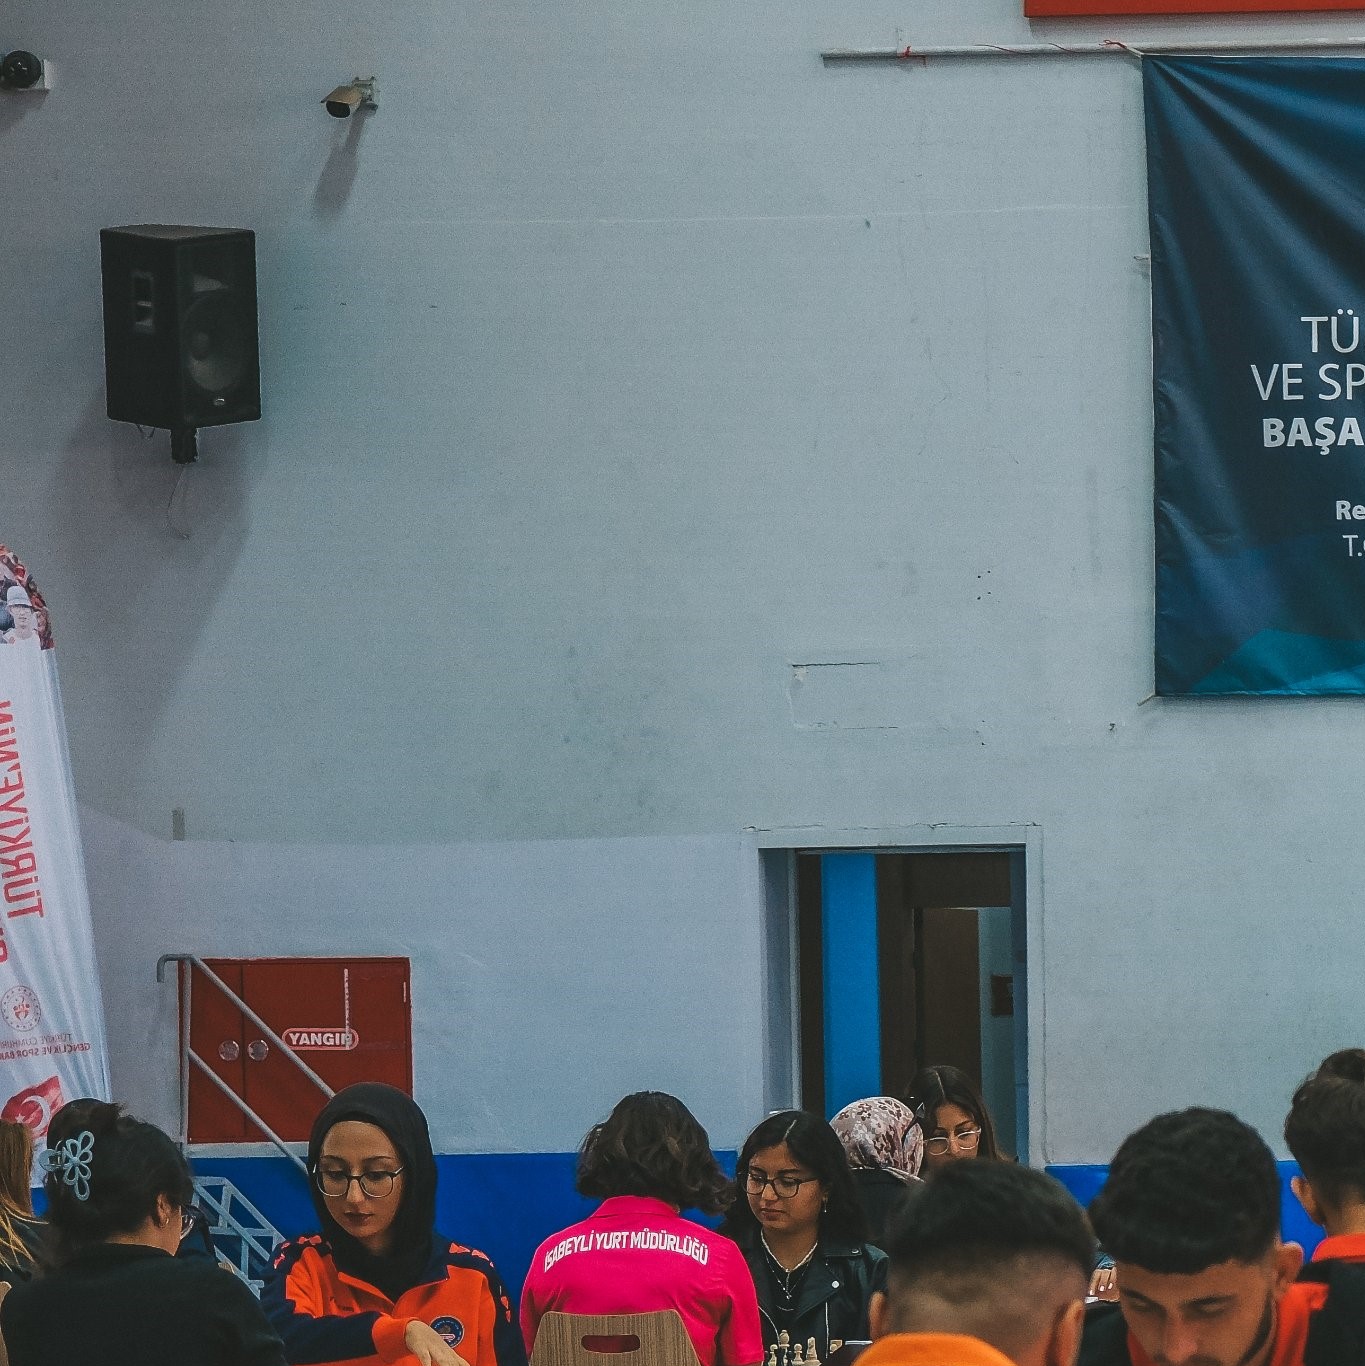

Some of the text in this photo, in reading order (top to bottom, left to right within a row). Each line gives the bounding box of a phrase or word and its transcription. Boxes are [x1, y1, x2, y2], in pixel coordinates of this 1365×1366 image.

[1251, 362, 1304, 401] VE
[596, 1231, 630, 1250] YURT
[629, 1228, 709, 1266] MÜDÜRLÜĞÜ
